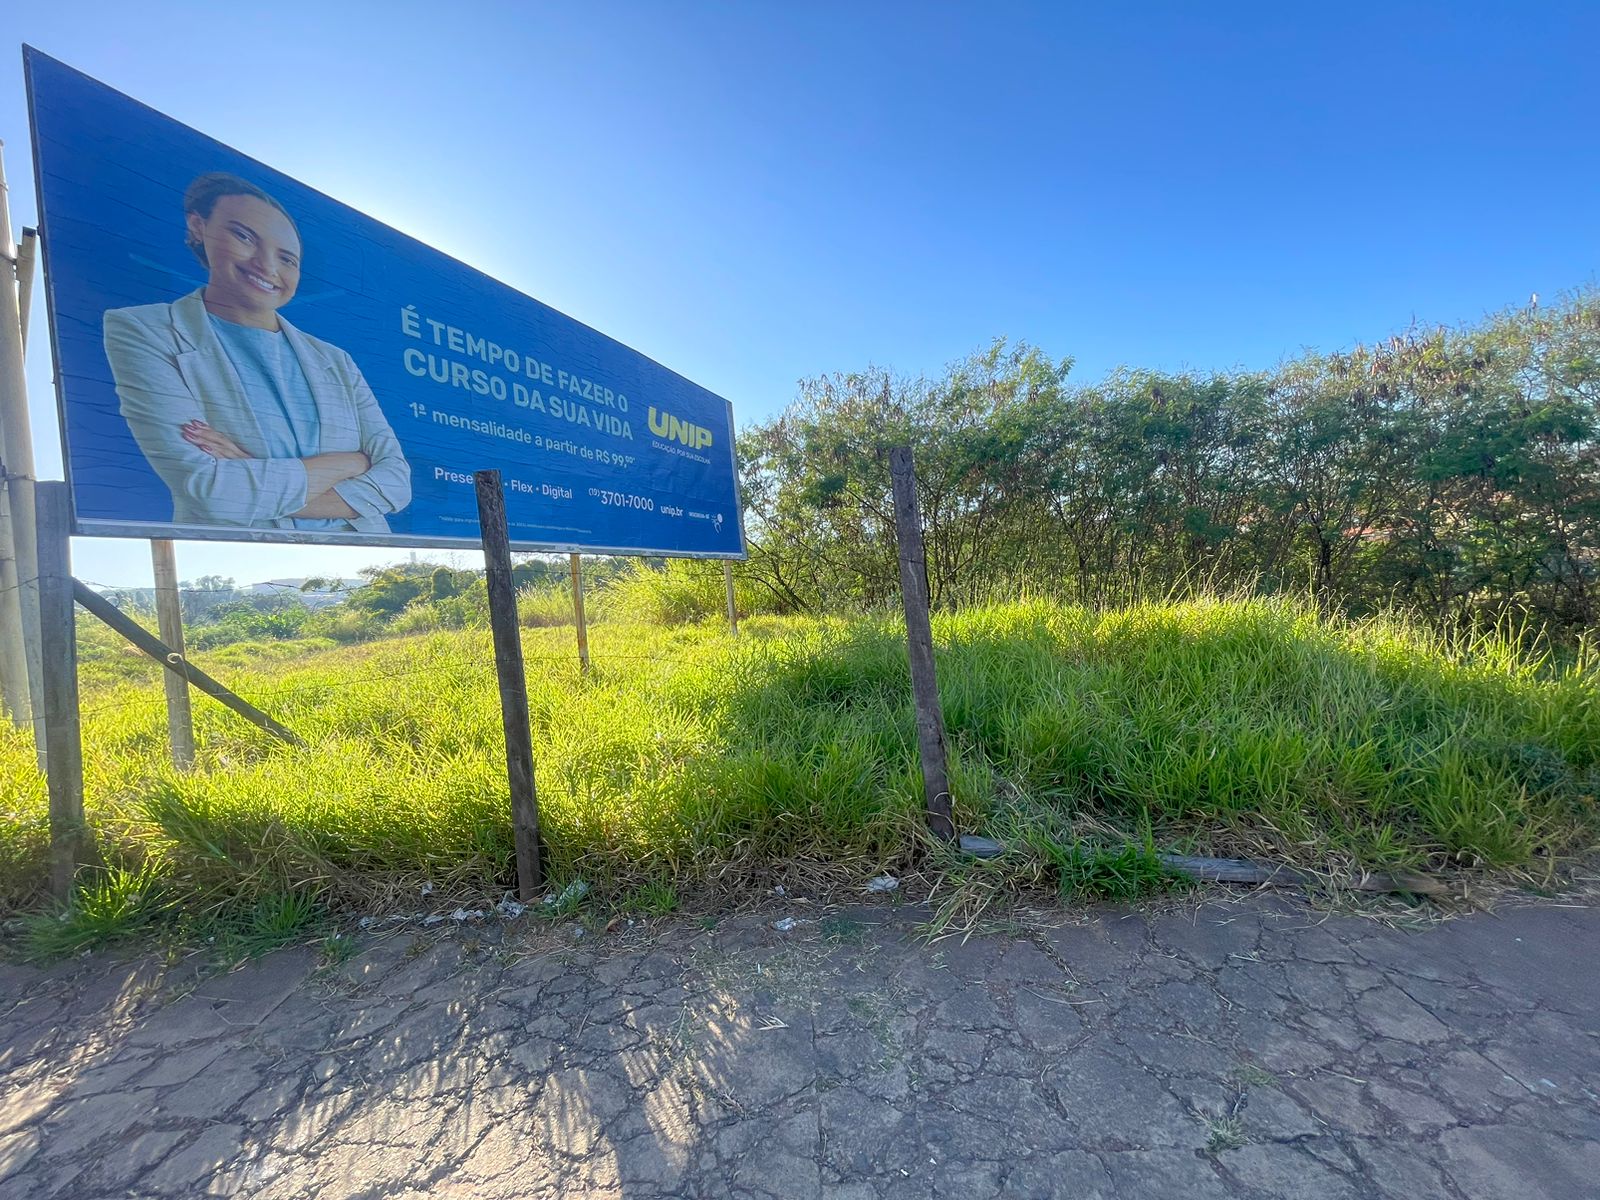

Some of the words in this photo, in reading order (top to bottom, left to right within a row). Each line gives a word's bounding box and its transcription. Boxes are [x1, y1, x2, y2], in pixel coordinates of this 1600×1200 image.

[401, 304, 422, 339] É
[426, 318, 520, 373] TEMPO
[525, 356, 554, 386] DE
[558, 369, 616, 409] FAZER
[618, 394, 629, 413] O
[403, 348, 507, 401] CURSO
[513, 383, 547, 414] DA
[549, 395, 592, 428] SUA
[592, 409, 634, 441] VIDA
[432, 410, 532, 443] mensalidade
[535, 435, 543, 447] a
[545, 438, 578, 456] partir
[580, 446, 594, 460] de
[596, 449, 611, 465] R$
[648, 406, 713, 450] UNIP
[434, 467, 474, 485] Prese
[511, 480, 533, 494] Flex
[542, 484, 573, 500] Digital
[660, 505, 684, 517] unip.br
